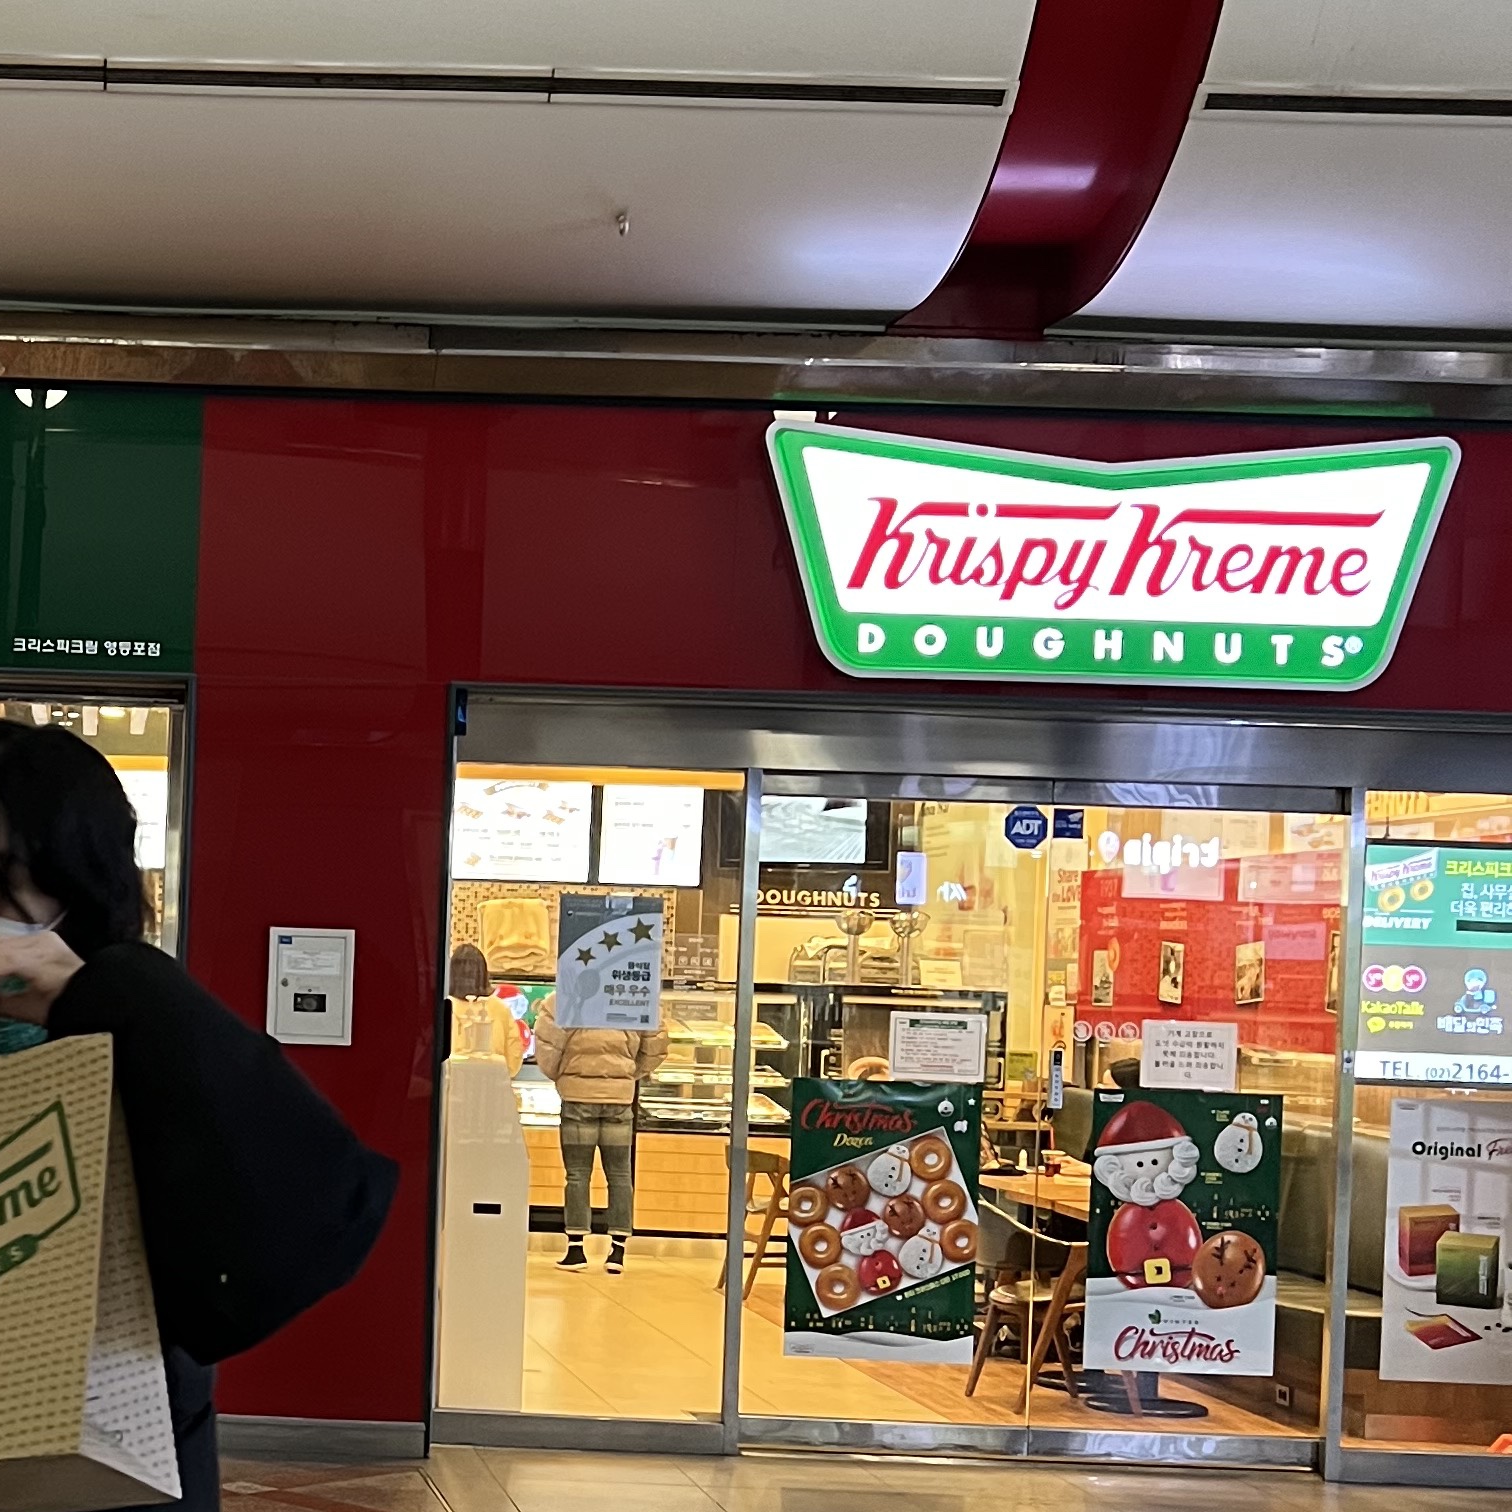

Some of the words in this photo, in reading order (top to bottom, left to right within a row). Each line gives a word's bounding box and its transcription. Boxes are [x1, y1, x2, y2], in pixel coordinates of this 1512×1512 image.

[847, 497, 1122, 610] Krispy
[1108, 503, 1385, 598] Kreme
[13, 637, 98, 654] 크리스피크림
[104, 640, 160, 656] 영등포점
[1011, 819, 1042, 835] ADT
[604, 984, 626, 996] 매우
[629, 984, 651, 997] 우수
[609, 999, 650, 1007] EXCELLENT
[1361, 1000, 1424, 1015] KakaoTalk
[801, 1098, 918, 1135] Christmas
[1412, 1141, 1482, 1160] Original
[1114, 1325, 1241, 1364] Christmas
